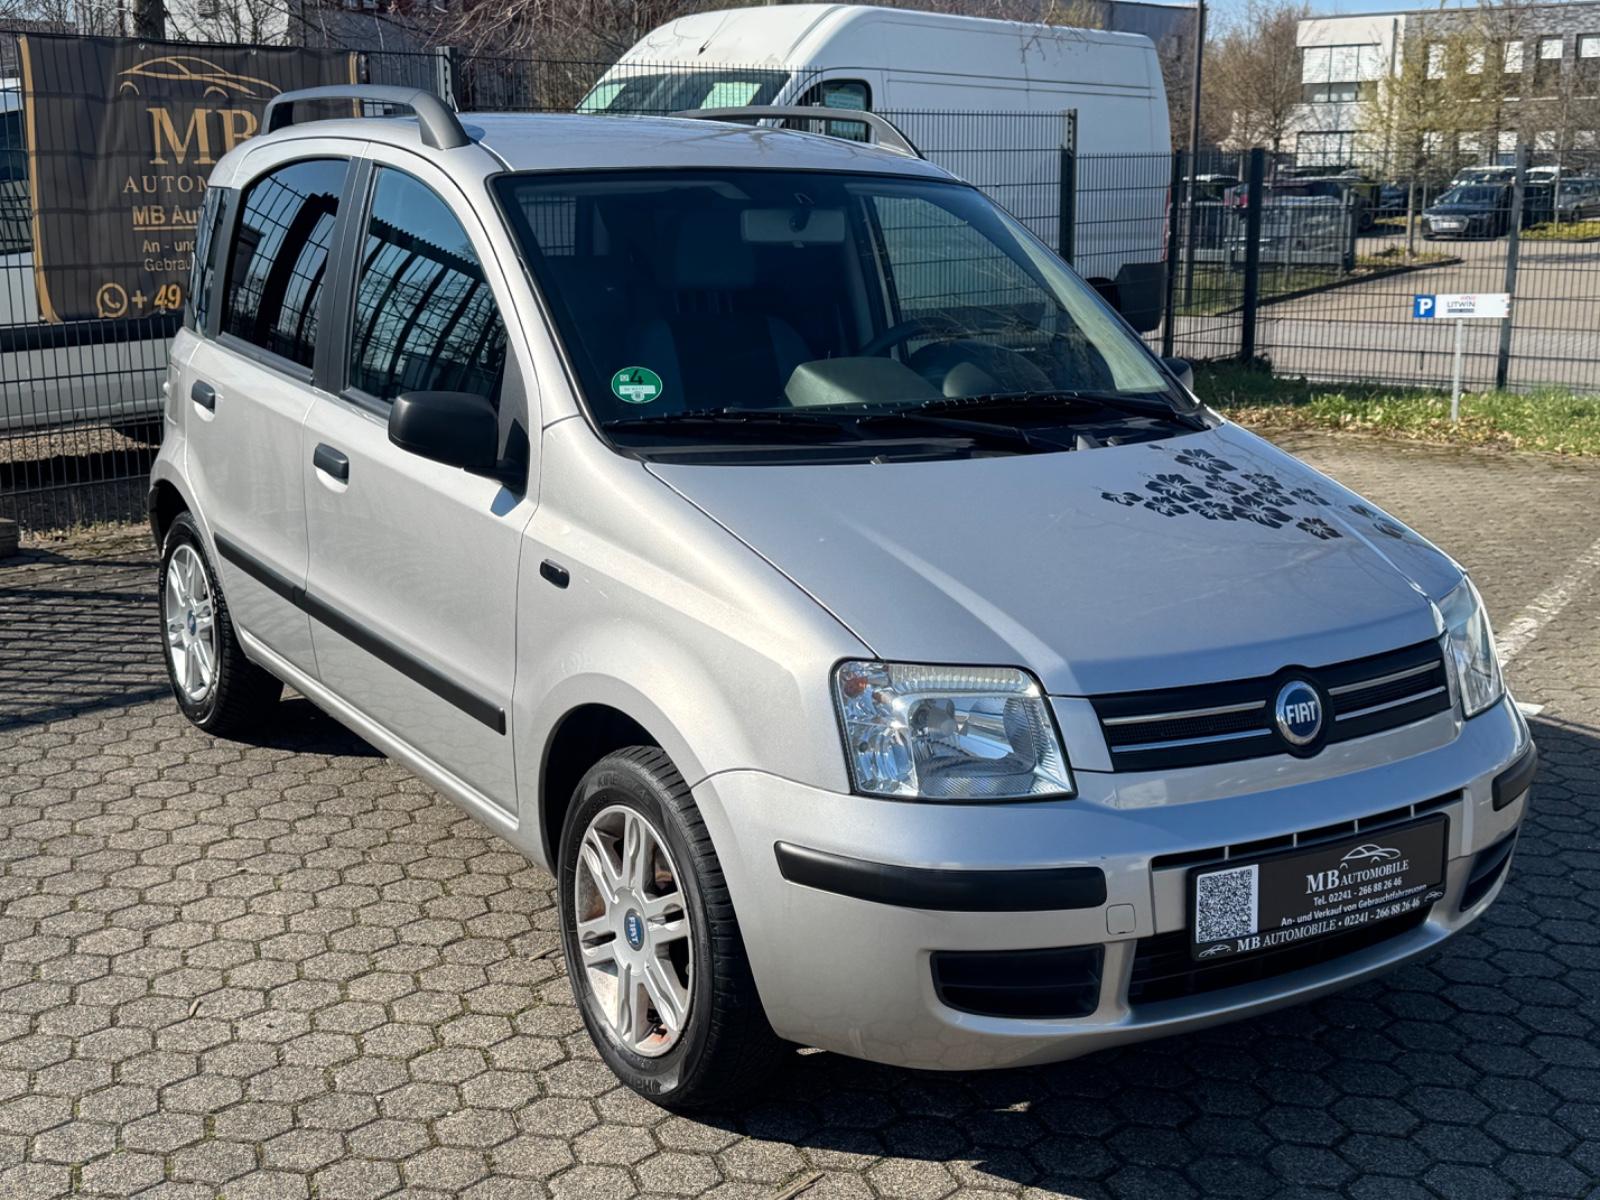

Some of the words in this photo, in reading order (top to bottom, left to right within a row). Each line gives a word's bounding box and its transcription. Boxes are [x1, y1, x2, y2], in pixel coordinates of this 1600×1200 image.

[146, 107, 258, 165] MB
[132, 205, 166, 225] MB
[142, 240, 160, 253] An
[153, 283, 182, 310] 49
[1417, 298, 1433, 315] P
[630, 369, 644, 385] 4
[1285, 701, 1316, 726] FIAT
[1305, 869, 1340, 895] MB
[1340, 859, 1410, 886] AUTOMOBILE
[1313, 896, 1327, 907] Tel.
[1328, 890, 1352, 903] 02241
[1358, 884, 1372, 896] 266
[1373, 882, 1382, 893] 88
[1383, 879, 1392, 890] 26
[1393, 877, 1402, 888] 46
[1236, 936, 1261, 953] MB
[1262, 919, 1337, 947] AUTOMOBILE
[1344, 911, 1369, 926] 02241
[1375, 906, 1391, 920] 266
[1391, 903, 1401, 915] 88
[1401, 900, 1411, 913] 26
[1411, 896, 1421, 909] 46
[1281, 917, 1296, 927] An-
[1297, 912, 1313, 923] und
[1314, 904, 1342, 919] Verkauf
[1343, 903, 1357, 913] von
[628, 916, 640, 944] FIAT
